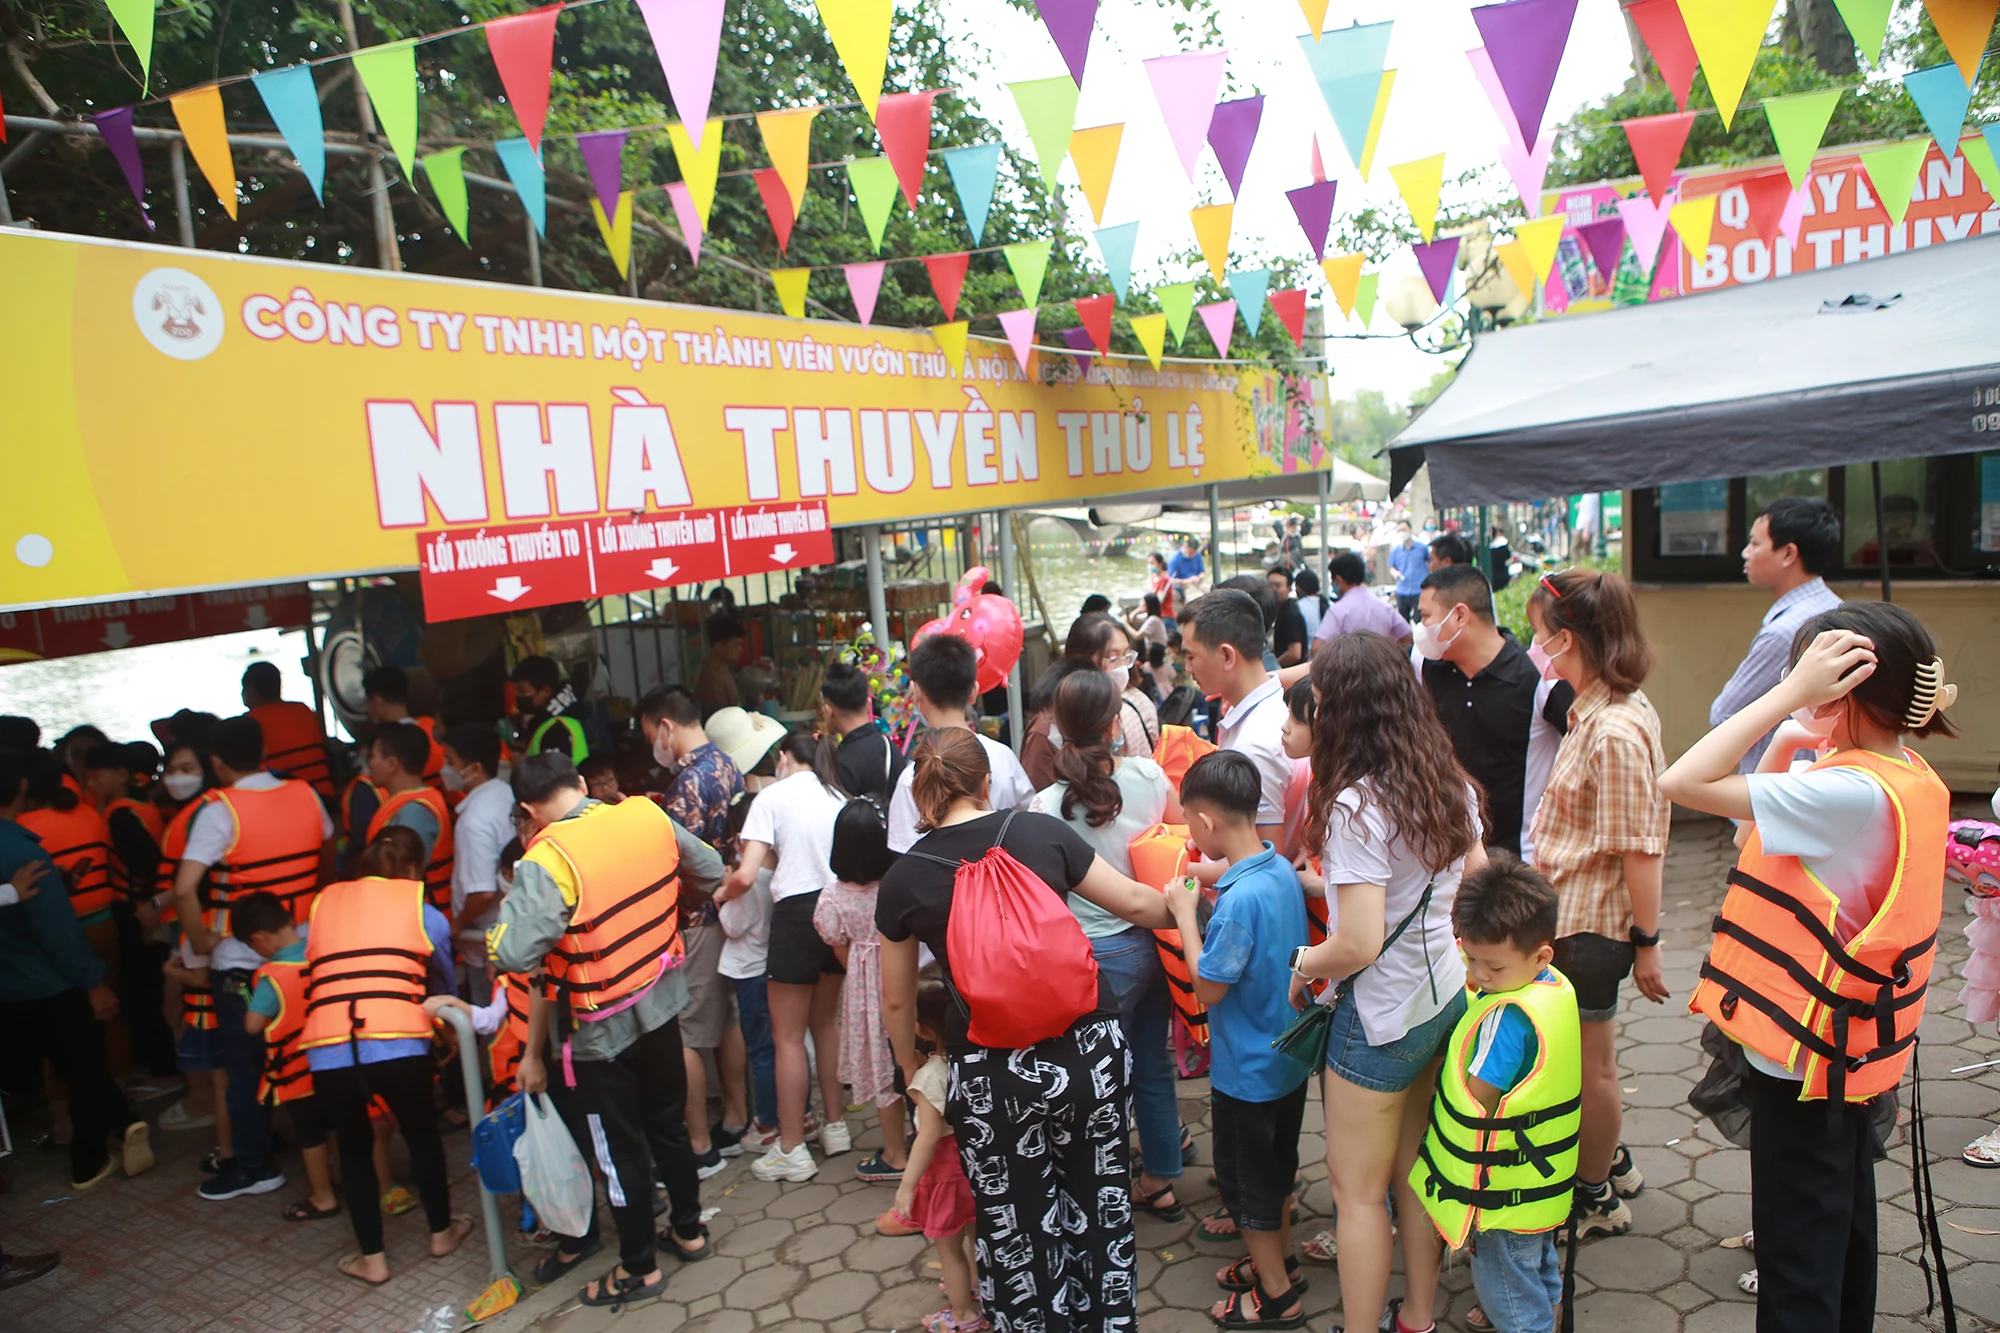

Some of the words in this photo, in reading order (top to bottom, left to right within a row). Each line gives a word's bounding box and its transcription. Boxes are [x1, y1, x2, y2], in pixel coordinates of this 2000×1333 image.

[242, 286, 402, 348] CÔNG
[407, 307, 467, 351] TY
[474, 313, 585, 358] TNHH
[591, 318, 667, 372] MỘT
[672, 325, 773, 369] THÀNH
[775, 333, 835, 373] VIÊN
[837, 340, 905, 377] VƯỜN
[947, 351, 976, 382] À
[978, 352, 1009, 388] NỘI
[365, 387, 693, 529] NHÀ
[724, 385, 1039, 502] THUYỀN
[1056, 396, 1152, 477] THỦ
[1166, 401, 1206, 478] LỆ
[455, 528, 509, 570] XUỐNG
[508, 522, 562, 563] THUYỀN
[561, 527, 581, 557] TO
[617, 516, 657, 552] XUỐNG
